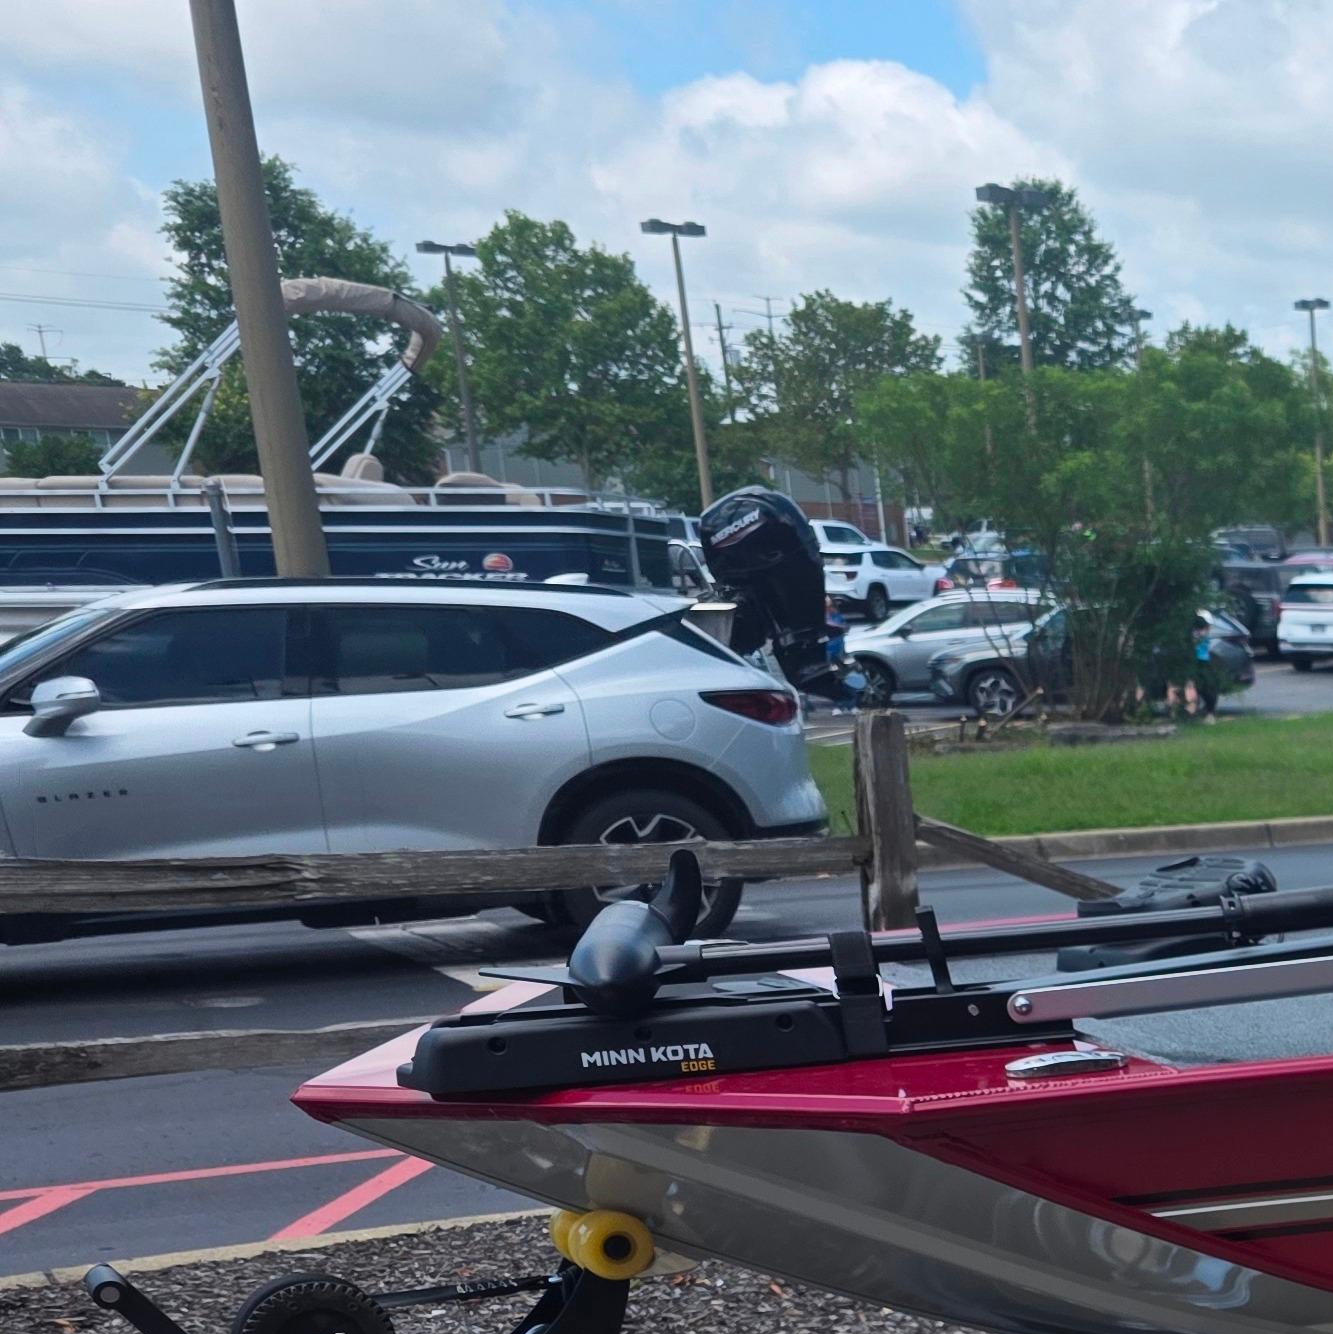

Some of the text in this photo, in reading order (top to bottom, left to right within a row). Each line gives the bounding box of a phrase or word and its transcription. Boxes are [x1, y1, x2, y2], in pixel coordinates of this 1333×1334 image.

[710, 508, 759, 545] MERCURY
[406, 555, 469, 571] Sun
[37, 789, 128, 803] BLAZER
[581, 1043, 714, 1068] MINN KOTA
[681, 1060, 716, 1072] EDGE
